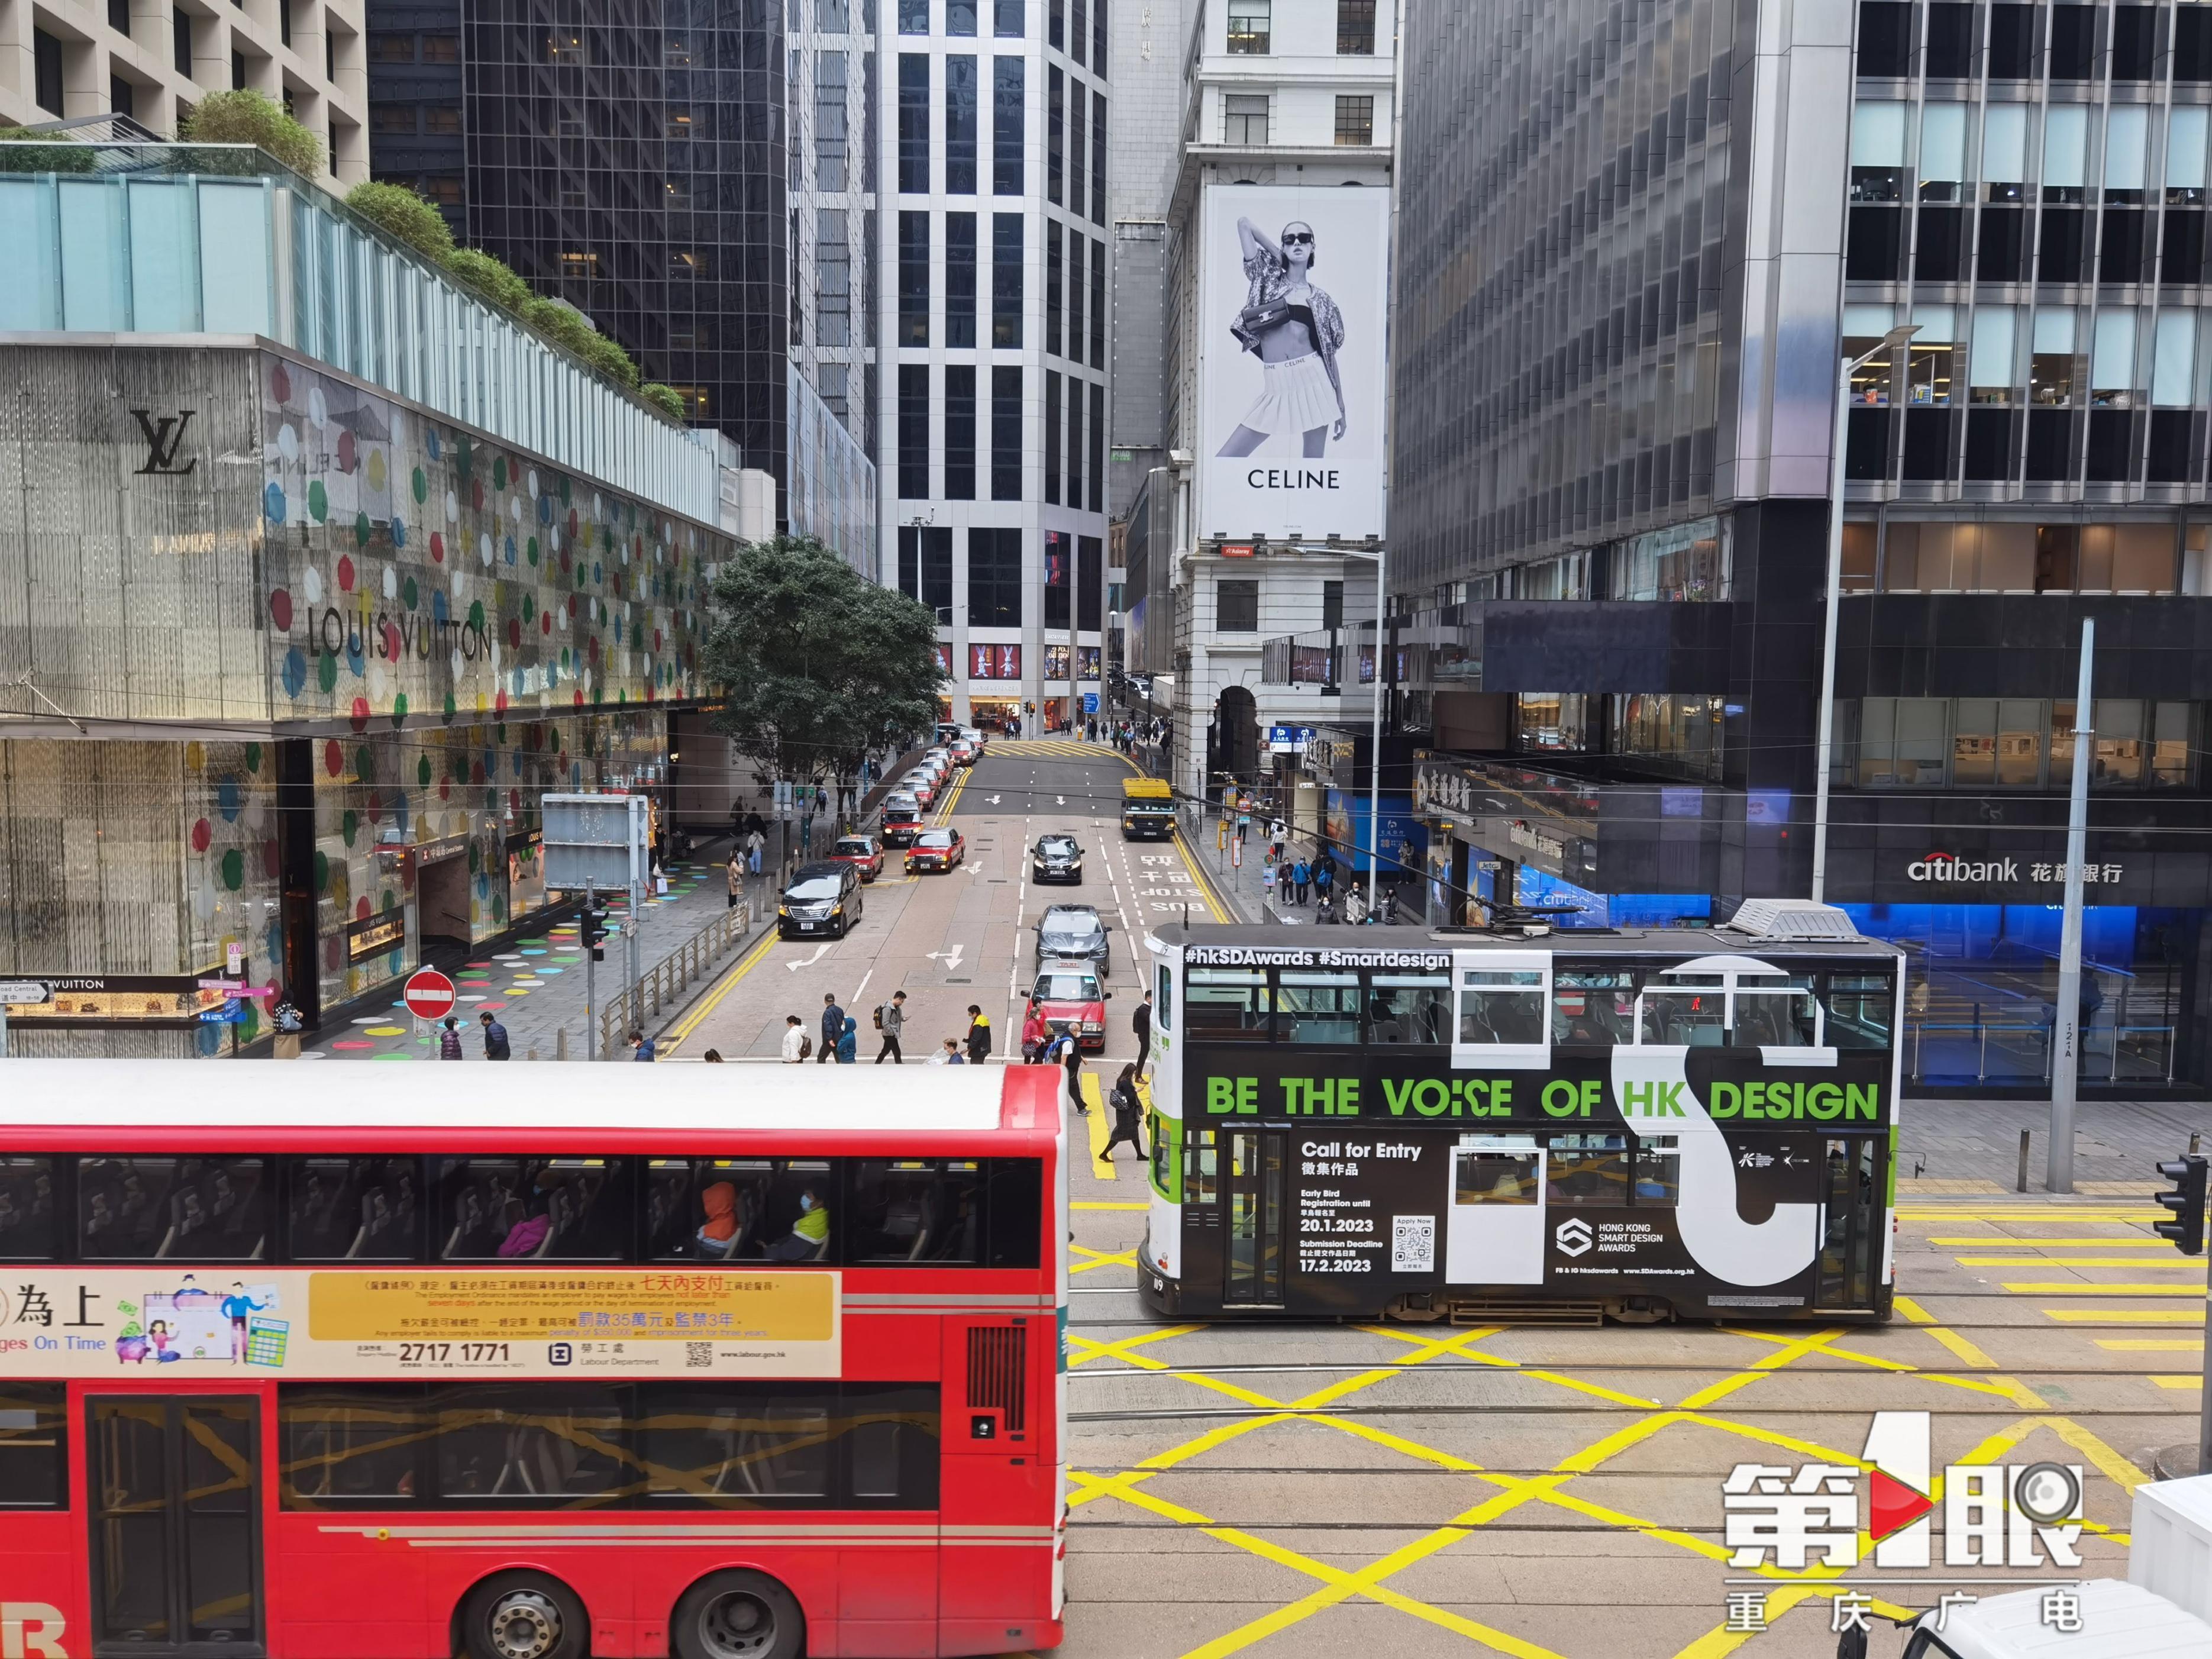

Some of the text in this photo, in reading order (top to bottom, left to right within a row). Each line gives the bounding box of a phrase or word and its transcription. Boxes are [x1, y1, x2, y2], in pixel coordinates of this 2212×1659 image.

[1248, 469, 1340, 489] CELINE
[308, 606, 495, 663] LOUIS VUITTON
[1907, 852, 2018, 882] citibank
[1151, 902, 1206, 912] BUS
[1185, 949, 1449, 970] #hkSDAwards #Smartdesign
[53, 980, 104, 989] VUITTON
[1207, 1077, 1258, 1114] BE
[1280, 1078, 1360, 1115] THE
[1541, 1080, 1602, 1117] OF
[1623, 1081, 1687, 1118] HK
[1710, 1082, 1878, 1120] DESIGN
[1302, 1141, 1422, 1161] Call for Entry
[1302, 1162, 1358, 1176] 徵集作品
[1301, 1189, 1322, 1198] Early
[1301, 1199, 1351, 1208] Registration
[1300, 1219, 1374, 1232] 20.1.2023
[1599, 1224, 1651, 1232] HONG KONG
[1599, 1234, 1663, 1243] SMART DESIGN
[1598, 1244, 1636, 1252] AWARDS
[1300, 1259, 1371, 1273] 17.2.2023
[1154, 1277, 1164, 1291] 119
[14, 1284, 105, 1327] 為上
[34, 1335, 58, 1350] On
[64, 1335, 106, 1350] Time
[581, 1343, 624, 1353] 勞工處
[400, 1343, 509, 1361] 2717 1771
